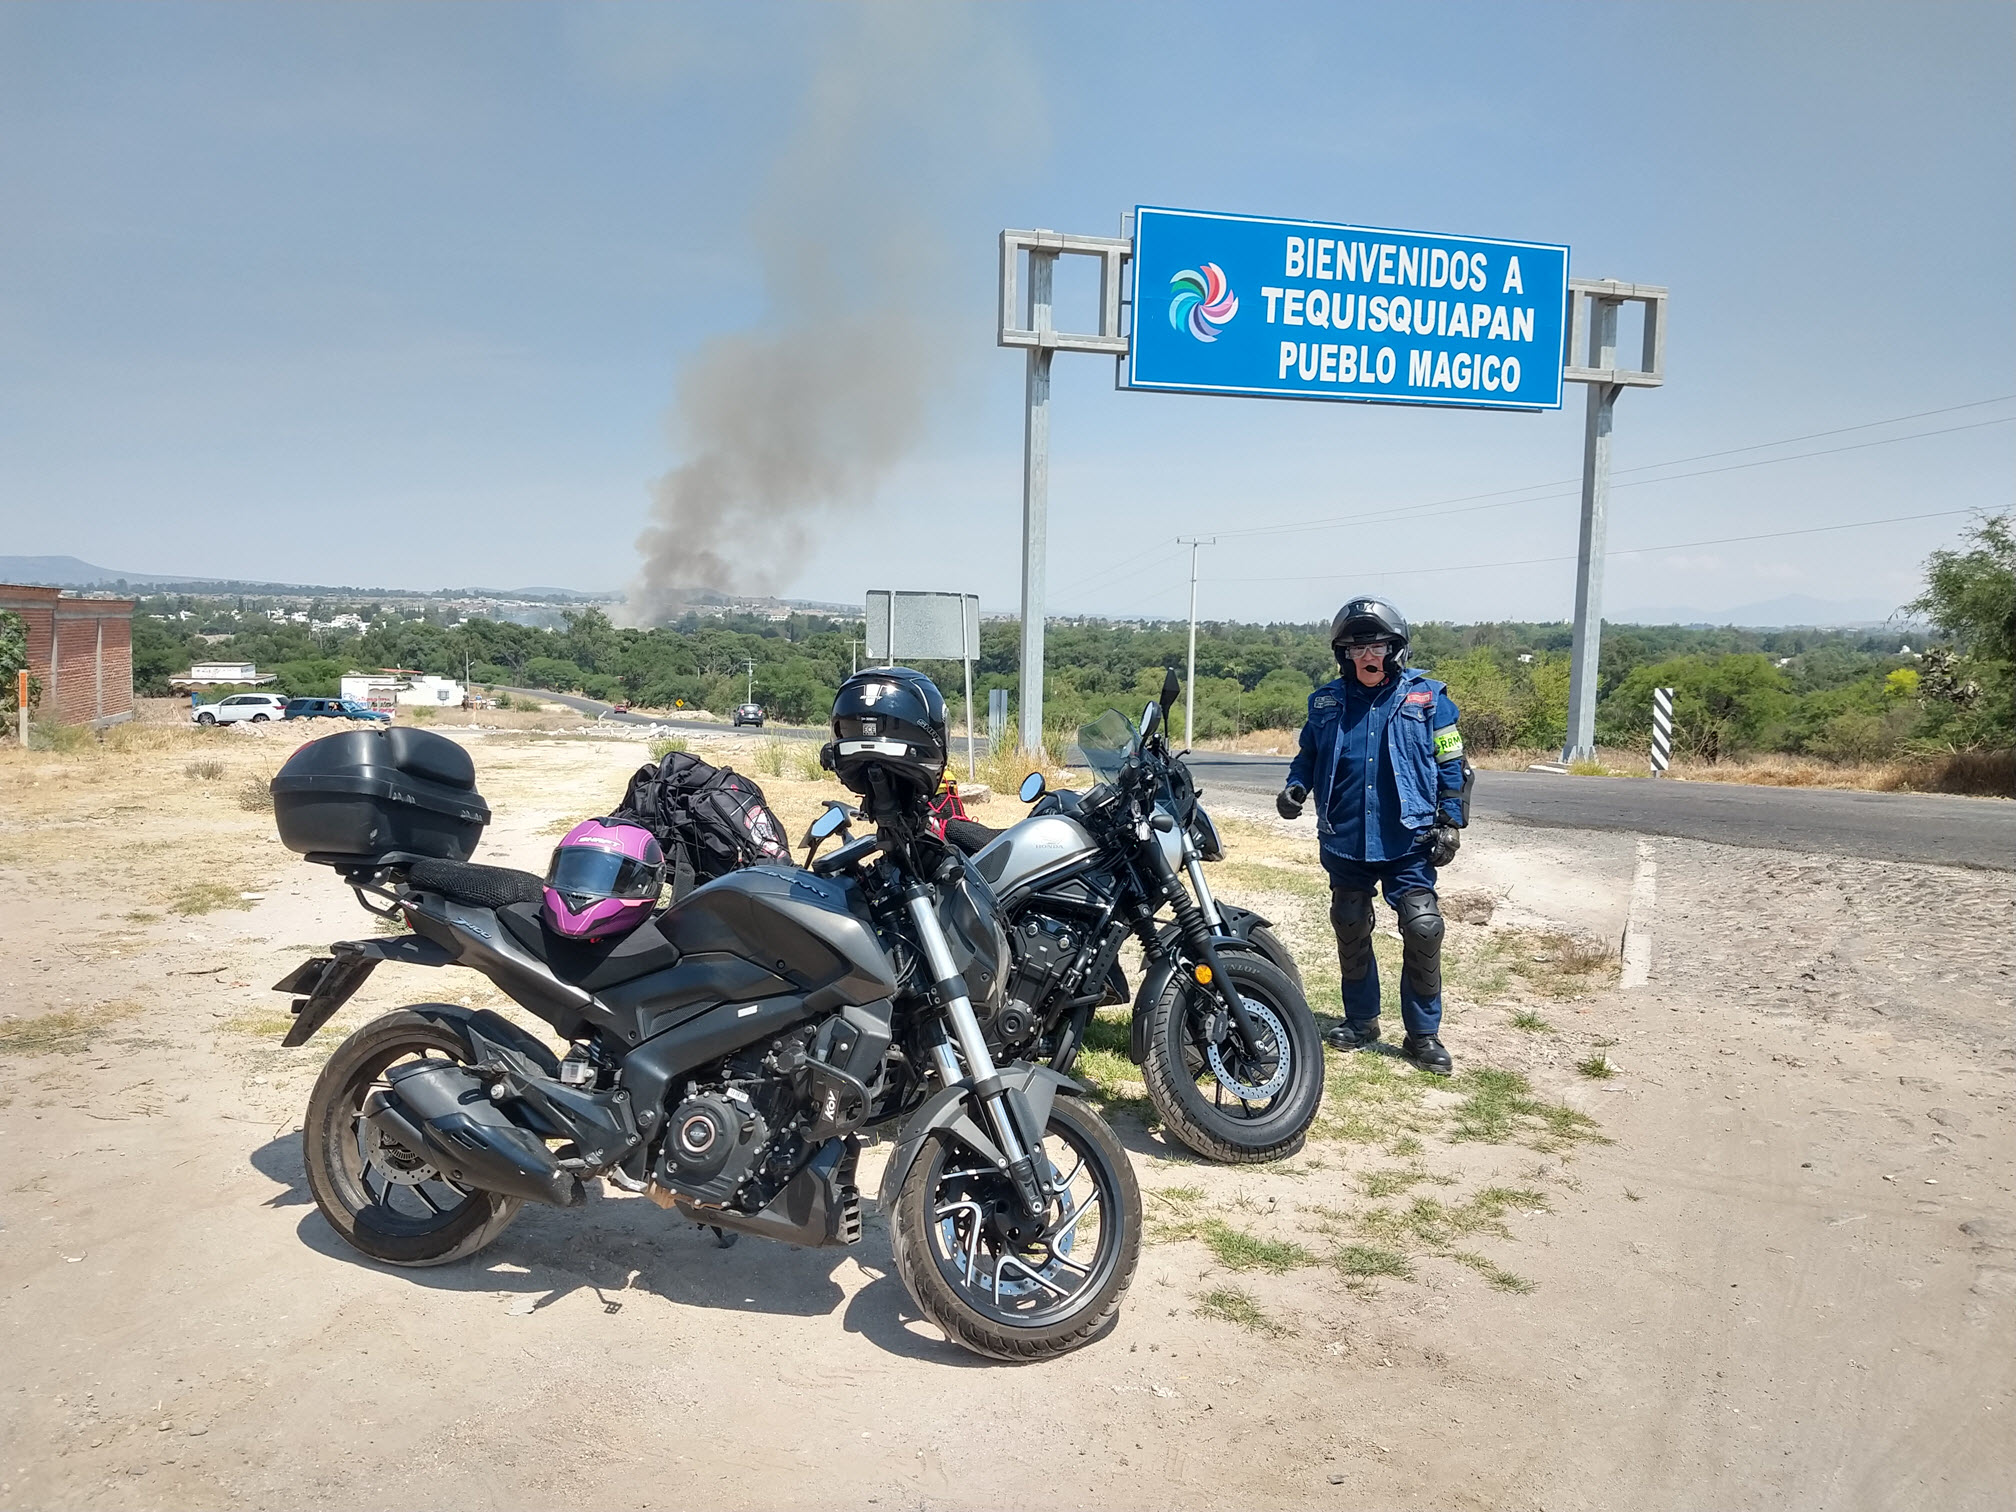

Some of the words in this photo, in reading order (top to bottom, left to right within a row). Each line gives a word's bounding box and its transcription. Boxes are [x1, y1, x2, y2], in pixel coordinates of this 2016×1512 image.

[1285, 236, 1487, 292] BIENVENIDOS
[1502, 255, 1524, 295] A
[1261, 286, 1535, 342] TEQUISQUIAPAN
[1278, 341, 1396, 384] PUEBLO
[1408, 349, 1521, 393] MAGICO
[863, 726, 876, 734] ECE
[1222, 963, 1260, 975] UNLOP
